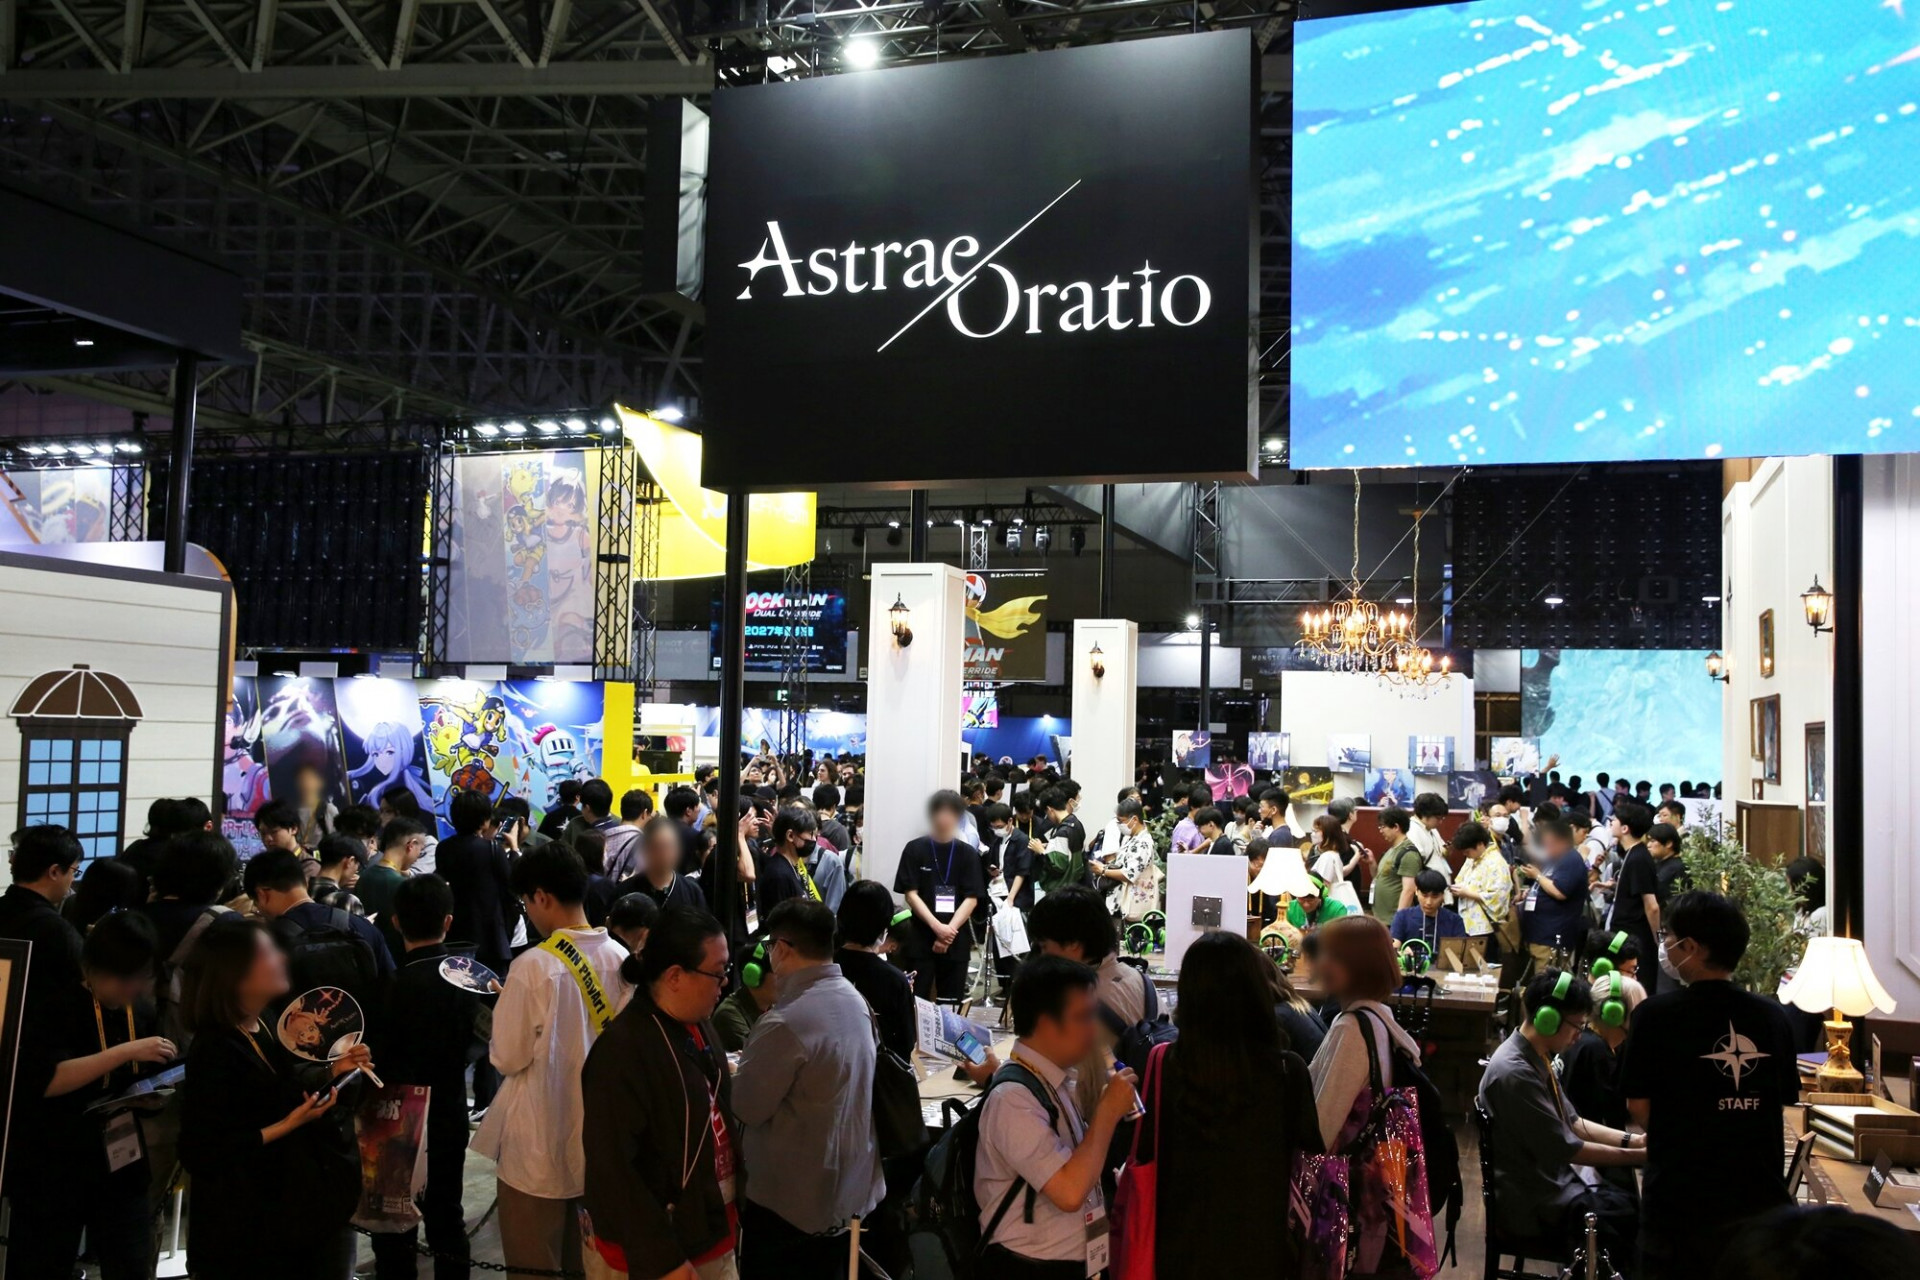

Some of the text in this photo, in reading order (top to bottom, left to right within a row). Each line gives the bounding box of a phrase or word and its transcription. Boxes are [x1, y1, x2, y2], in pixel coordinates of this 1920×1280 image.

[737, 220, 979, 300] Astrae
[947, 259, 1212, 338] Oratio
[556, 939, 582, 966] NHN
[579, 963, 606, 1014] PlayArt
[1718, 1097, 1760, 1111] STAFF
